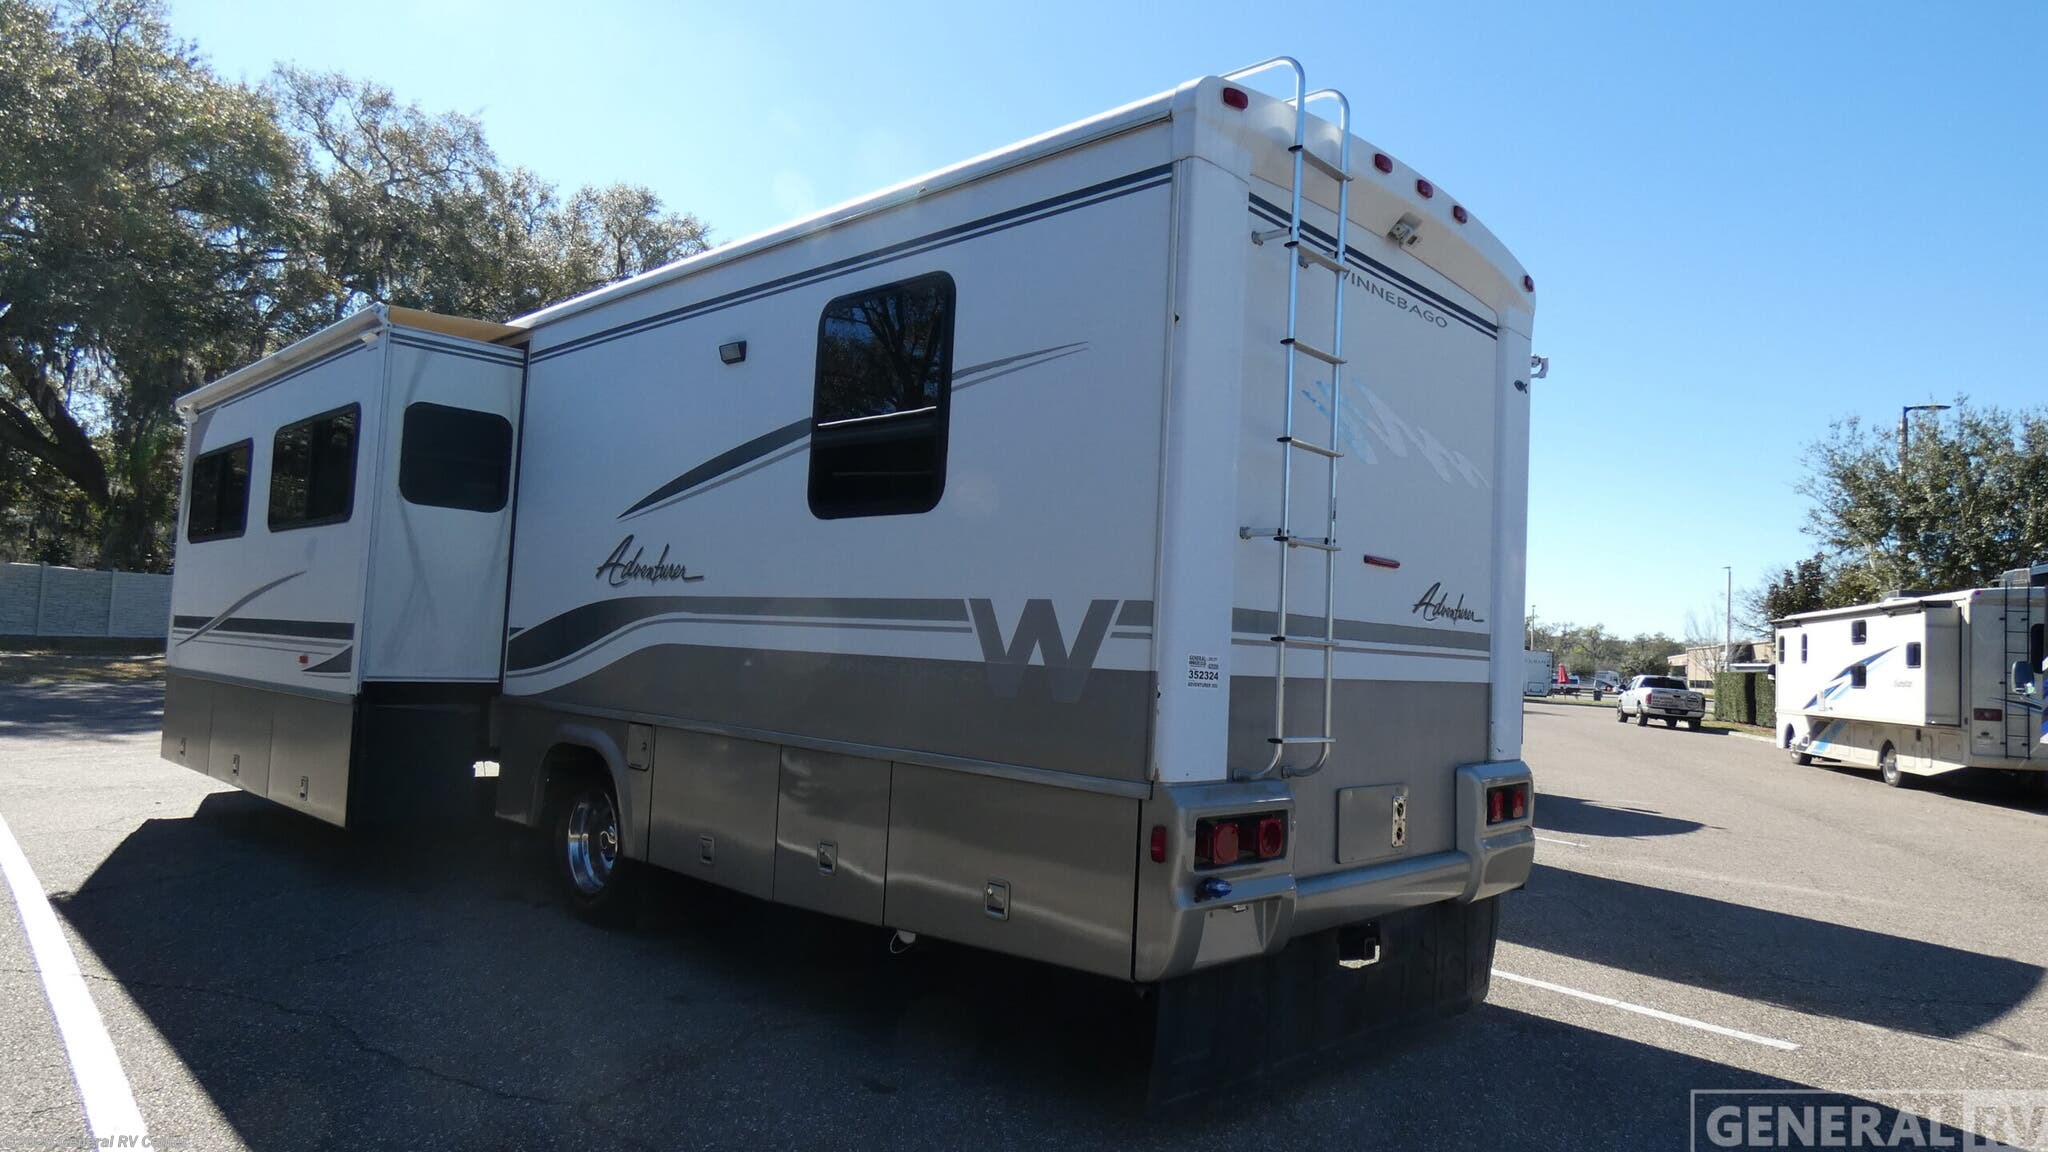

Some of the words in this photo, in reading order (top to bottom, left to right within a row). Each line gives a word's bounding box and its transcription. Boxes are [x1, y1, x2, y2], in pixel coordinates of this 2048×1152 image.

[1343, 269, 1448, 328] INNEBAGO
[595, 534, 704, 586] Adventurer
[1412, 582, 1484, 624] Adventurer
[968, 598, 1120, 704] W
[1188, 669, 1219, 681] 352324
